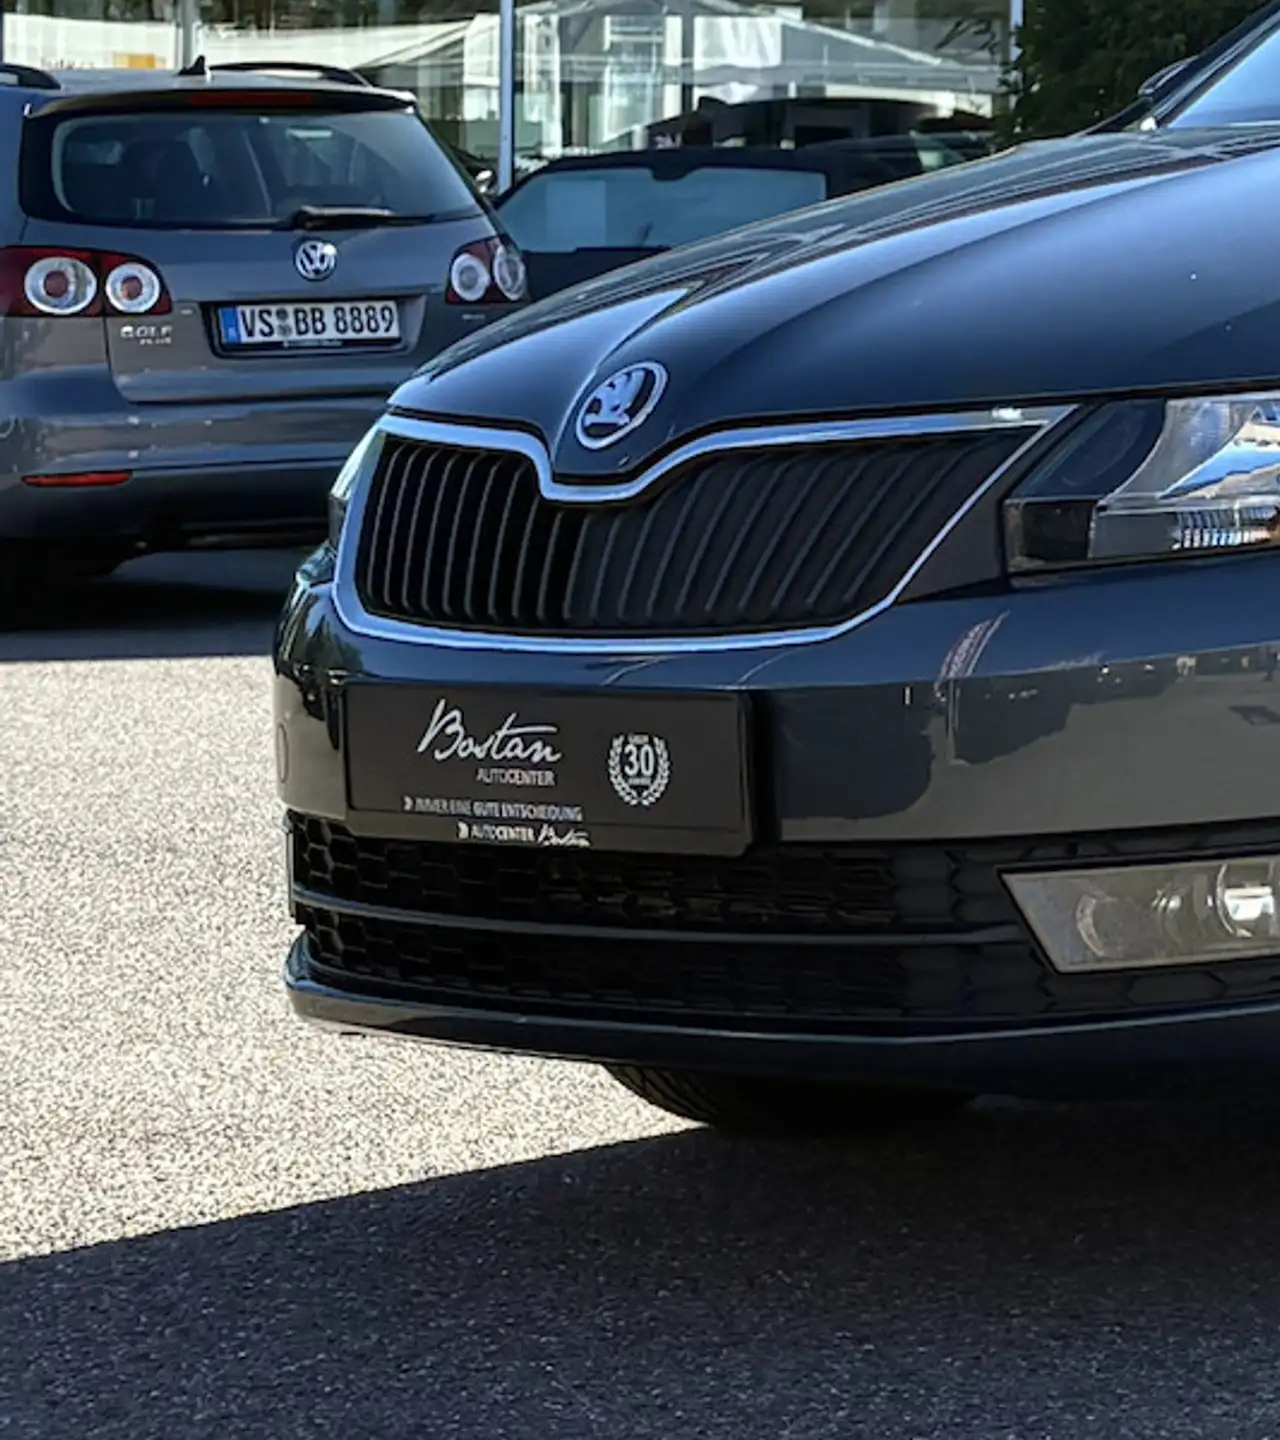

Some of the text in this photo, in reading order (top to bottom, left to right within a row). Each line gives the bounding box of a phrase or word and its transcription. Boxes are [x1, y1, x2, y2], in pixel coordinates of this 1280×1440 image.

[240, 305, 395, 338] VS BB 8889
[417, 698, 563, 762] Bostan
[624, 743, 655, 777] 30
[476, 767, 556, 787] AUTOCENTER
